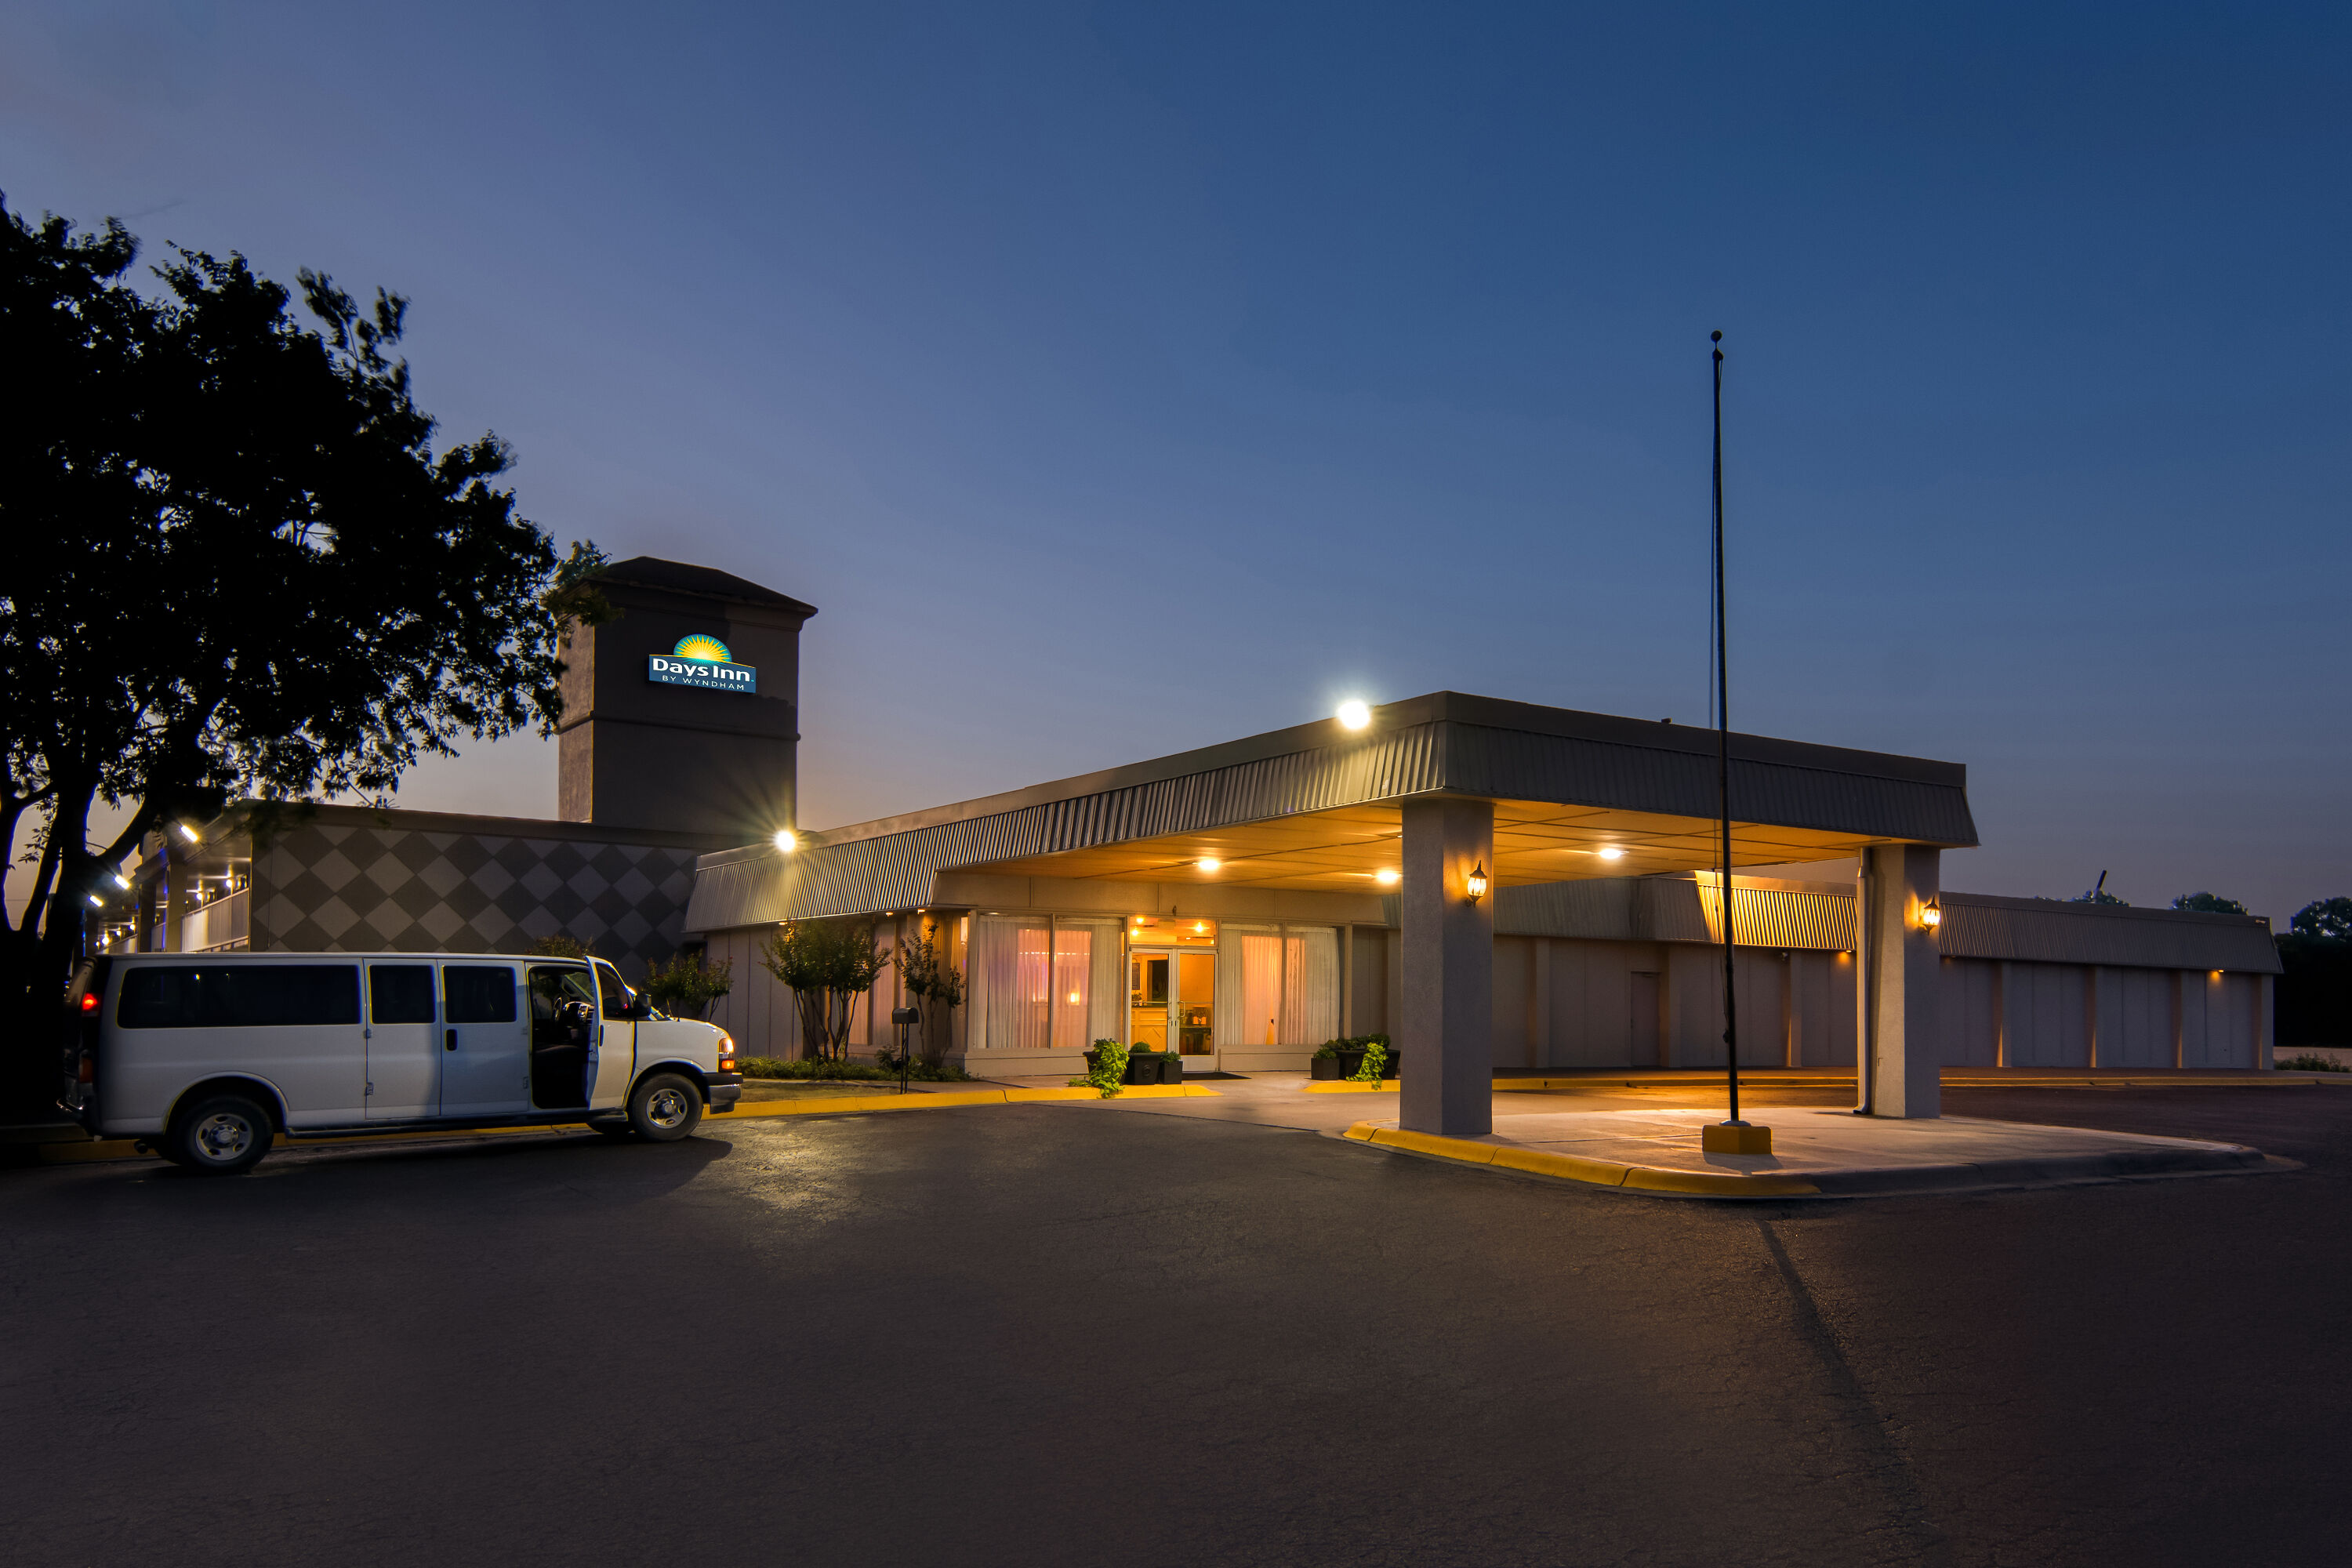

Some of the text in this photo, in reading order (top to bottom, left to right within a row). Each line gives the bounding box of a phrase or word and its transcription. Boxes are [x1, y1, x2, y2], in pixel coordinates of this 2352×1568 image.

[652, 658, 750, 682] Days Inn
[683, 677, 744, 691] WYNDHAM
